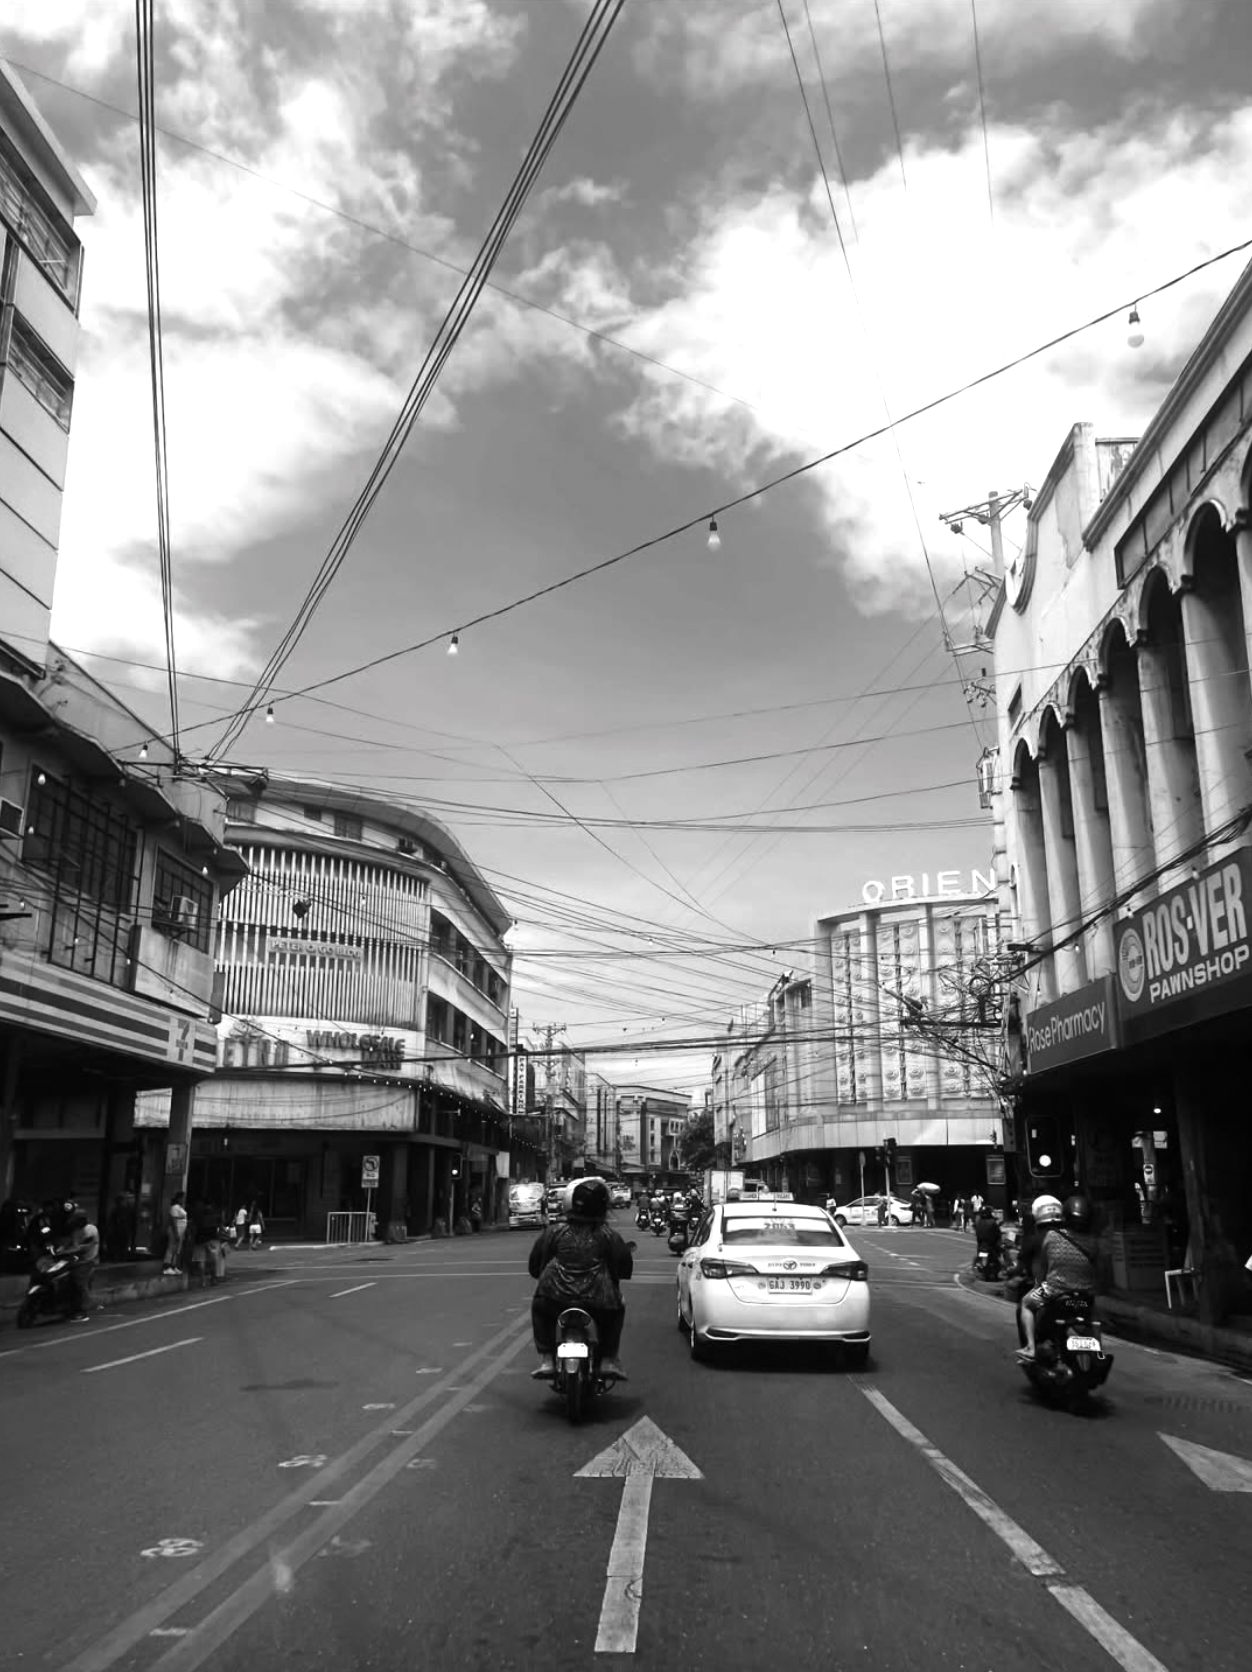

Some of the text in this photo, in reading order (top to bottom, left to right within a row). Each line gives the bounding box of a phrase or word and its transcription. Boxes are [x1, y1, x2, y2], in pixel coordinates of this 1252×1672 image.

[863, 868, 997, 903] ORIEN
[1142, 863, 1248, 981] ROS-VER
[1150, 944, 1250, 1004] PAWNSHOP
[789, 1280, 811, 1290] 3990
